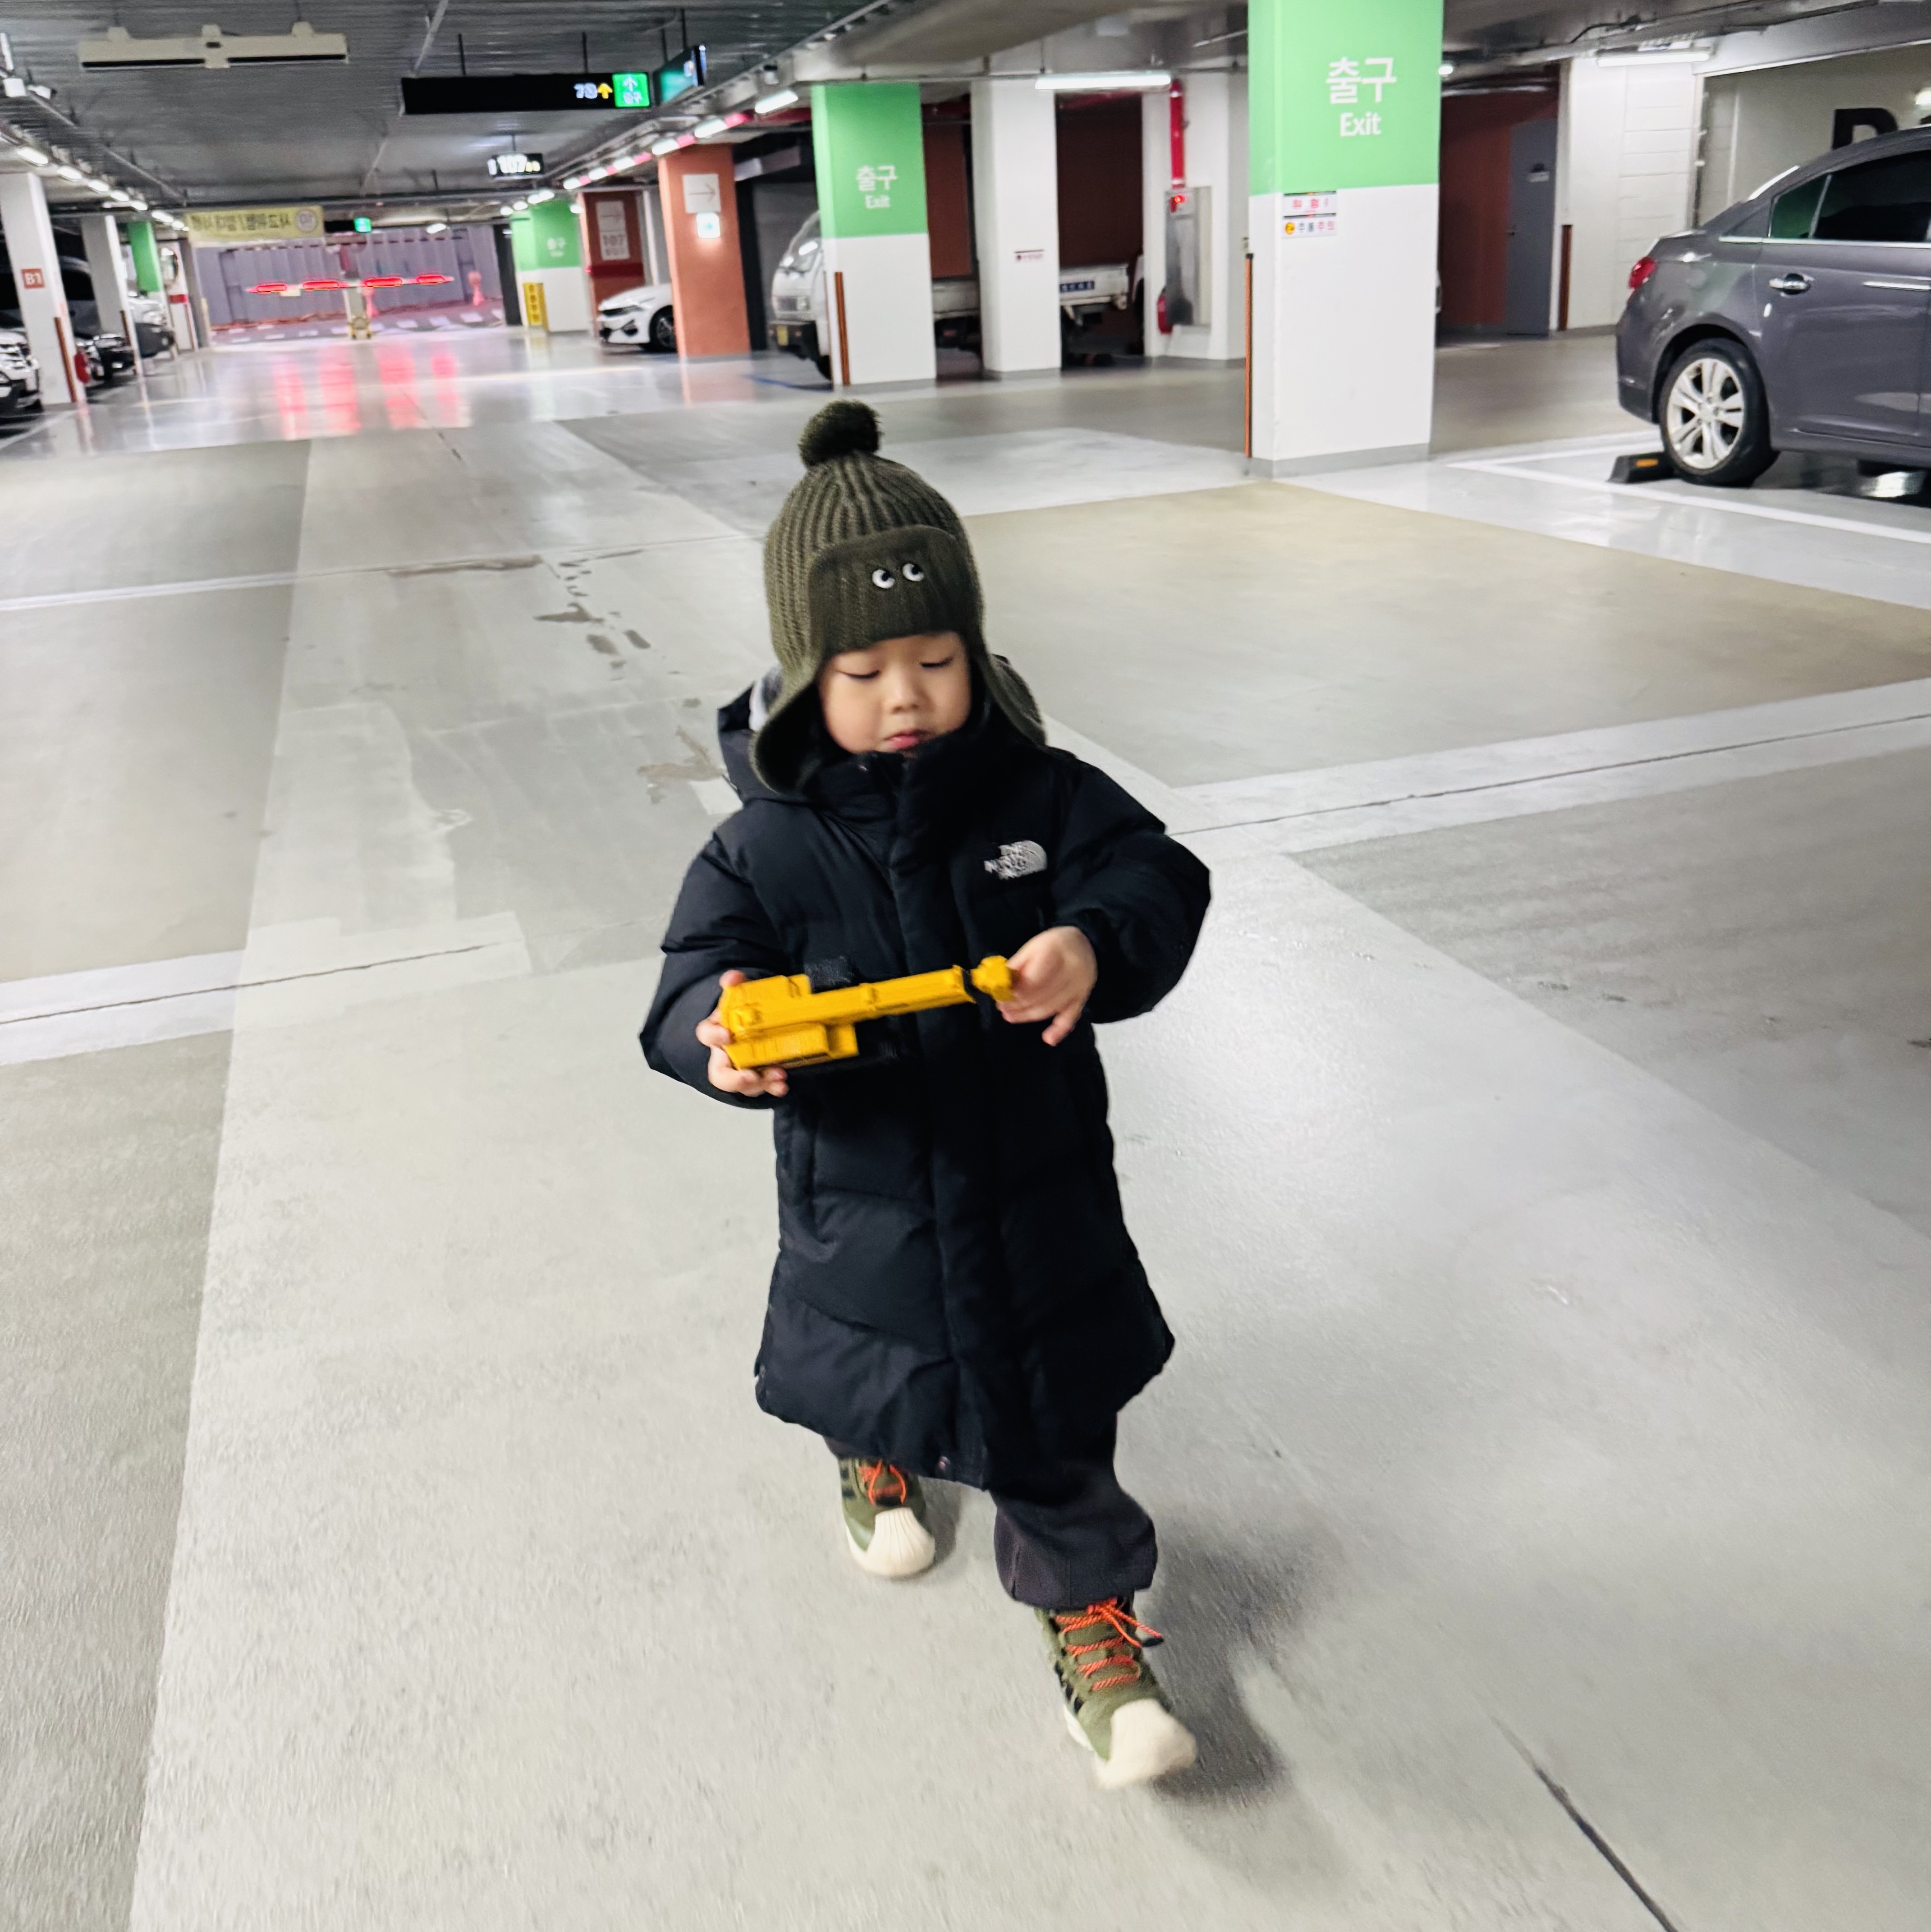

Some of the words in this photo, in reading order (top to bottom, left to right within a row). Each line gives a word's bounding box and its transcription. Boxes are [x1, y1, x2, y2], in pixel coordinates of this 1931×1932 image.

[1325, 56, 1397, 104] 출구
[1339, 111, 1381, 137] Exit
[856, 165, 898, 191] 출구
[865, 195, 890, 208] Exit
[24, 273, 42, 285] B1
